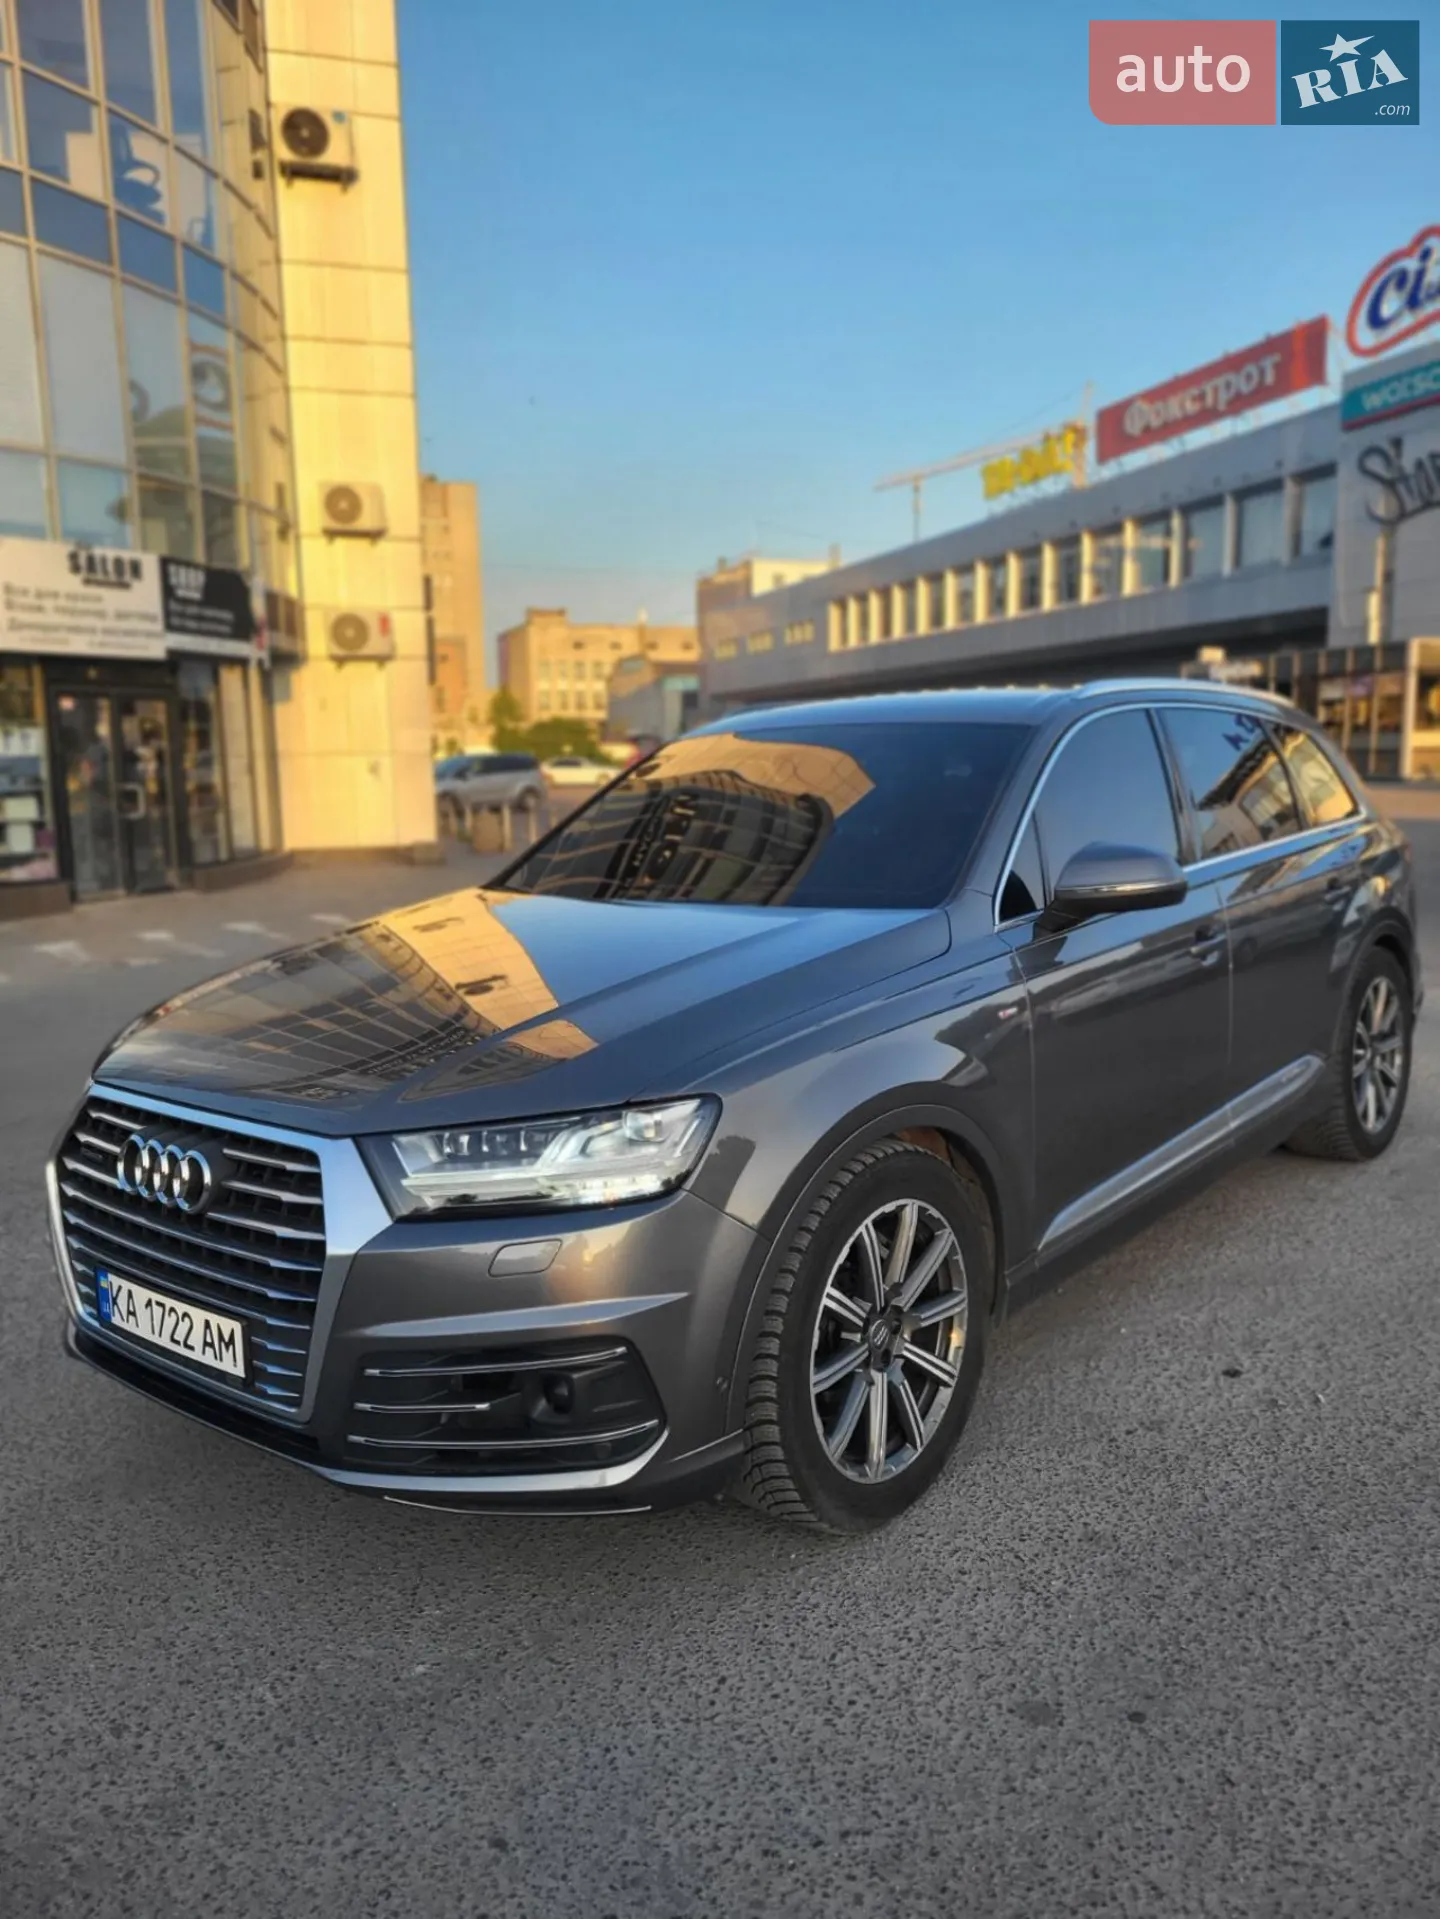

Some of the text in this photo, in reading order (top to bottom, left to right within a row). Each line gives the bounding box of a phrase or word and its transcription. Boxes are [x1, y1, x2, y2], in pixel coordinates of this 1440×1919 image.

[1123, 353, 1281, 438] Фокстрот
[68, 551, 143, 581] SALON
[109, 1281, 238, 1368] KA 1722 AM
